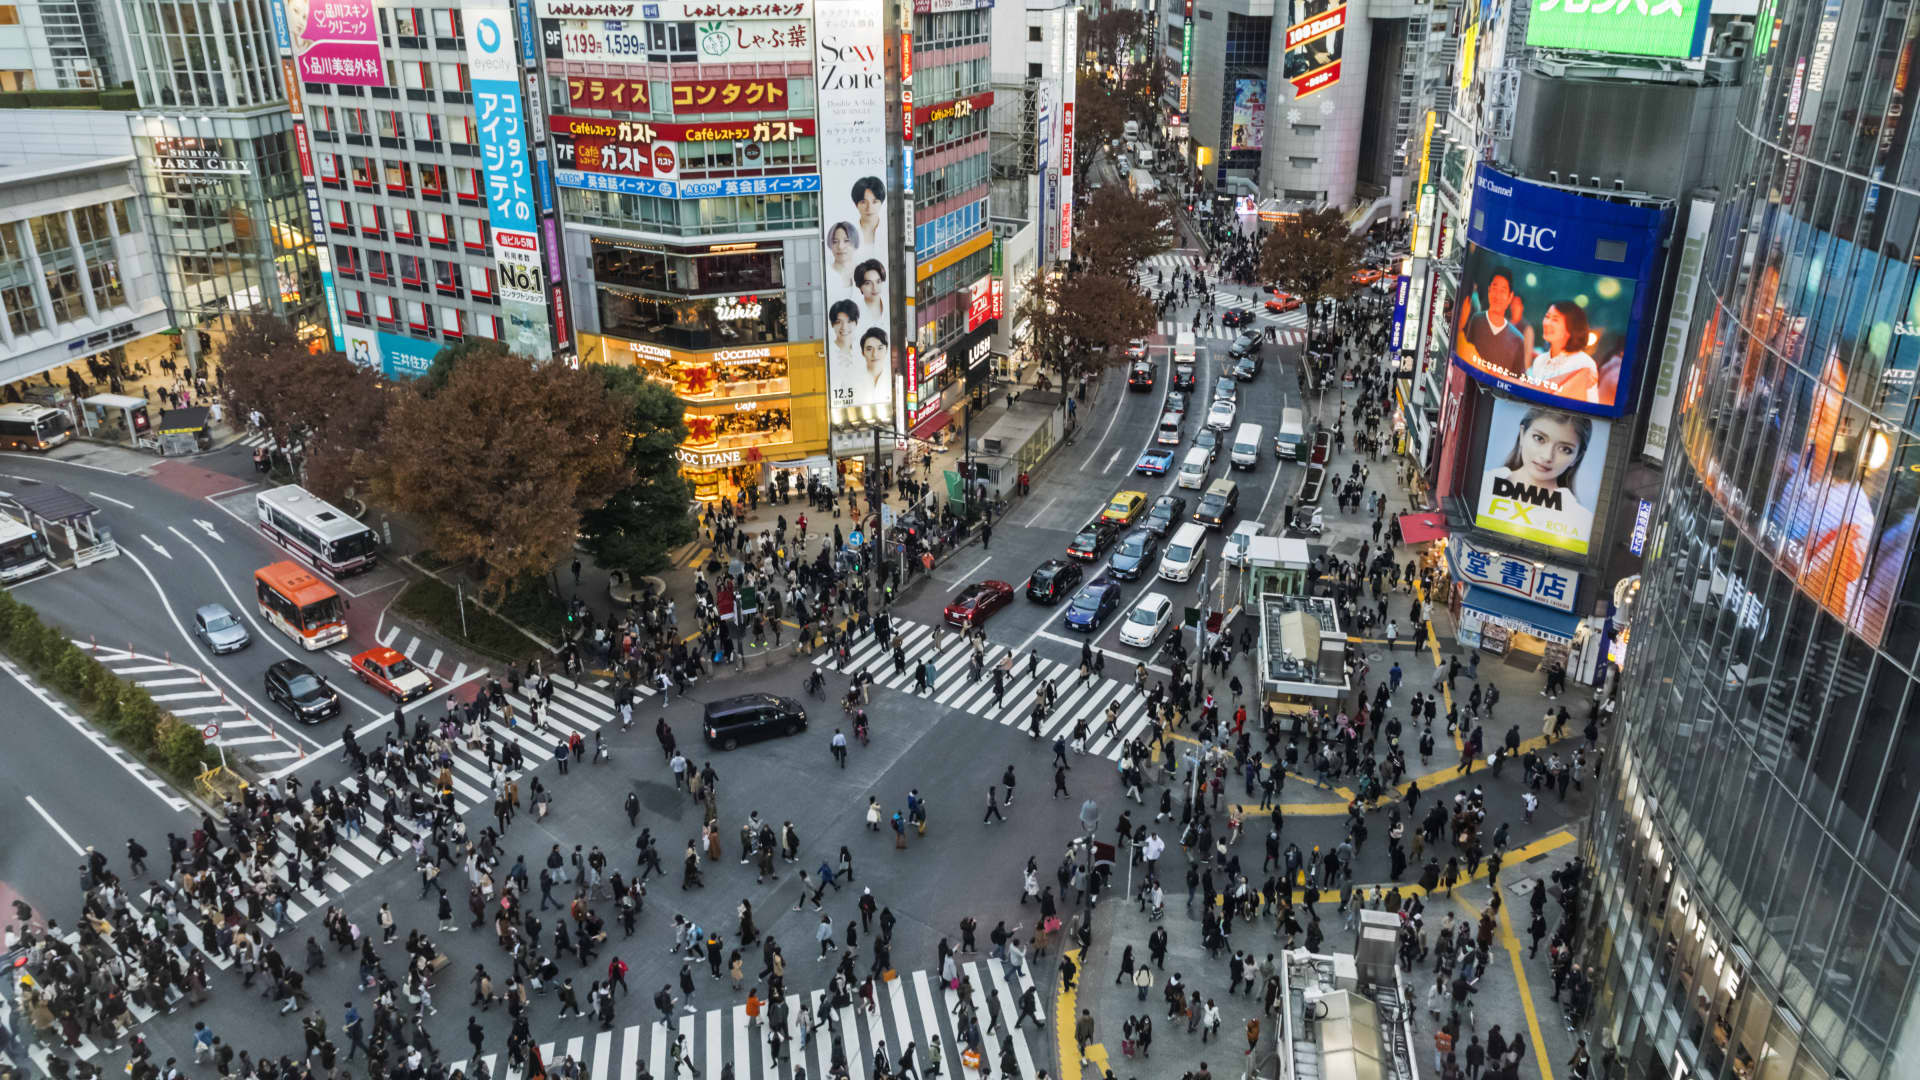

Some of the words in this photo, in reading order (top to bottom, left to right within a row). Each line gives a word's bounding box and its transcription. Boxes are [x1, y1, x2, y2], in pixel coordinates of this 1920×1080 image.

[325, 3, 368, 18] 品川スキン
[547, 3, 634, 16] しゃぶしゃぶバイキング
[683, 3, 804, 17] しゃぶしゃぶバイキング
[328, 20, 367, 34] クリニック
[546, 30, 560, 45] 9F
[737, 24, 807, 49] しゃぶ葉
[820, 35, 880, 72] Sexy
[311, 57, 378, 79] 品川美容外科
[821, 65, 882, 90] Zone
[569, 80, 648, 104] プライス
[673, 82, 784, 105] コンタクト
[955, 100, 973, 118] ガスト
[618, 121, 657, 143] ガスト
[685, 128, 750, 142] Caféレストラン
[753, 122, 803, 142] ガスト
[478, 92, 512, 218] アイシティ
[501, 93, 529, 220] コンタクトの
[557, 143, 575, 160] 7F
[578, 145, 599, 157] Café
[601, 145, 648, 172] ガスト
[149, 158, 199, 169] MARK
[206, 158, 249, 170] CITY
[657, 157, 673, 166] ガスト
[587, 175, 656, 193] 英会話イーオン
[686, 184, 717, 194] AEON
[725, 178, 817, 195] 英会話イーオン
[1477, 176, 1487, 189] DHC
[1487, 180, 1513, 197] Channel
[1502, 218, 1556, 252] DHC
[498, 262, 543, 293] No.1
[501, 290, 544, 303] コンタクトショップ
[629, 342, 671, 358] L'OCCITANE
[714, 348, 770, 361] L'OCCITANE
[968, 335, 990, 365] LUSH
[833, 388, 854, 399] 12.5
[1496, 380, 1512, 392] DHC
[669, 449, 741, 465] OCCITANE
[1492, 476, 1562, 511] DMM
[1488, 498, 1537, 525] FX
